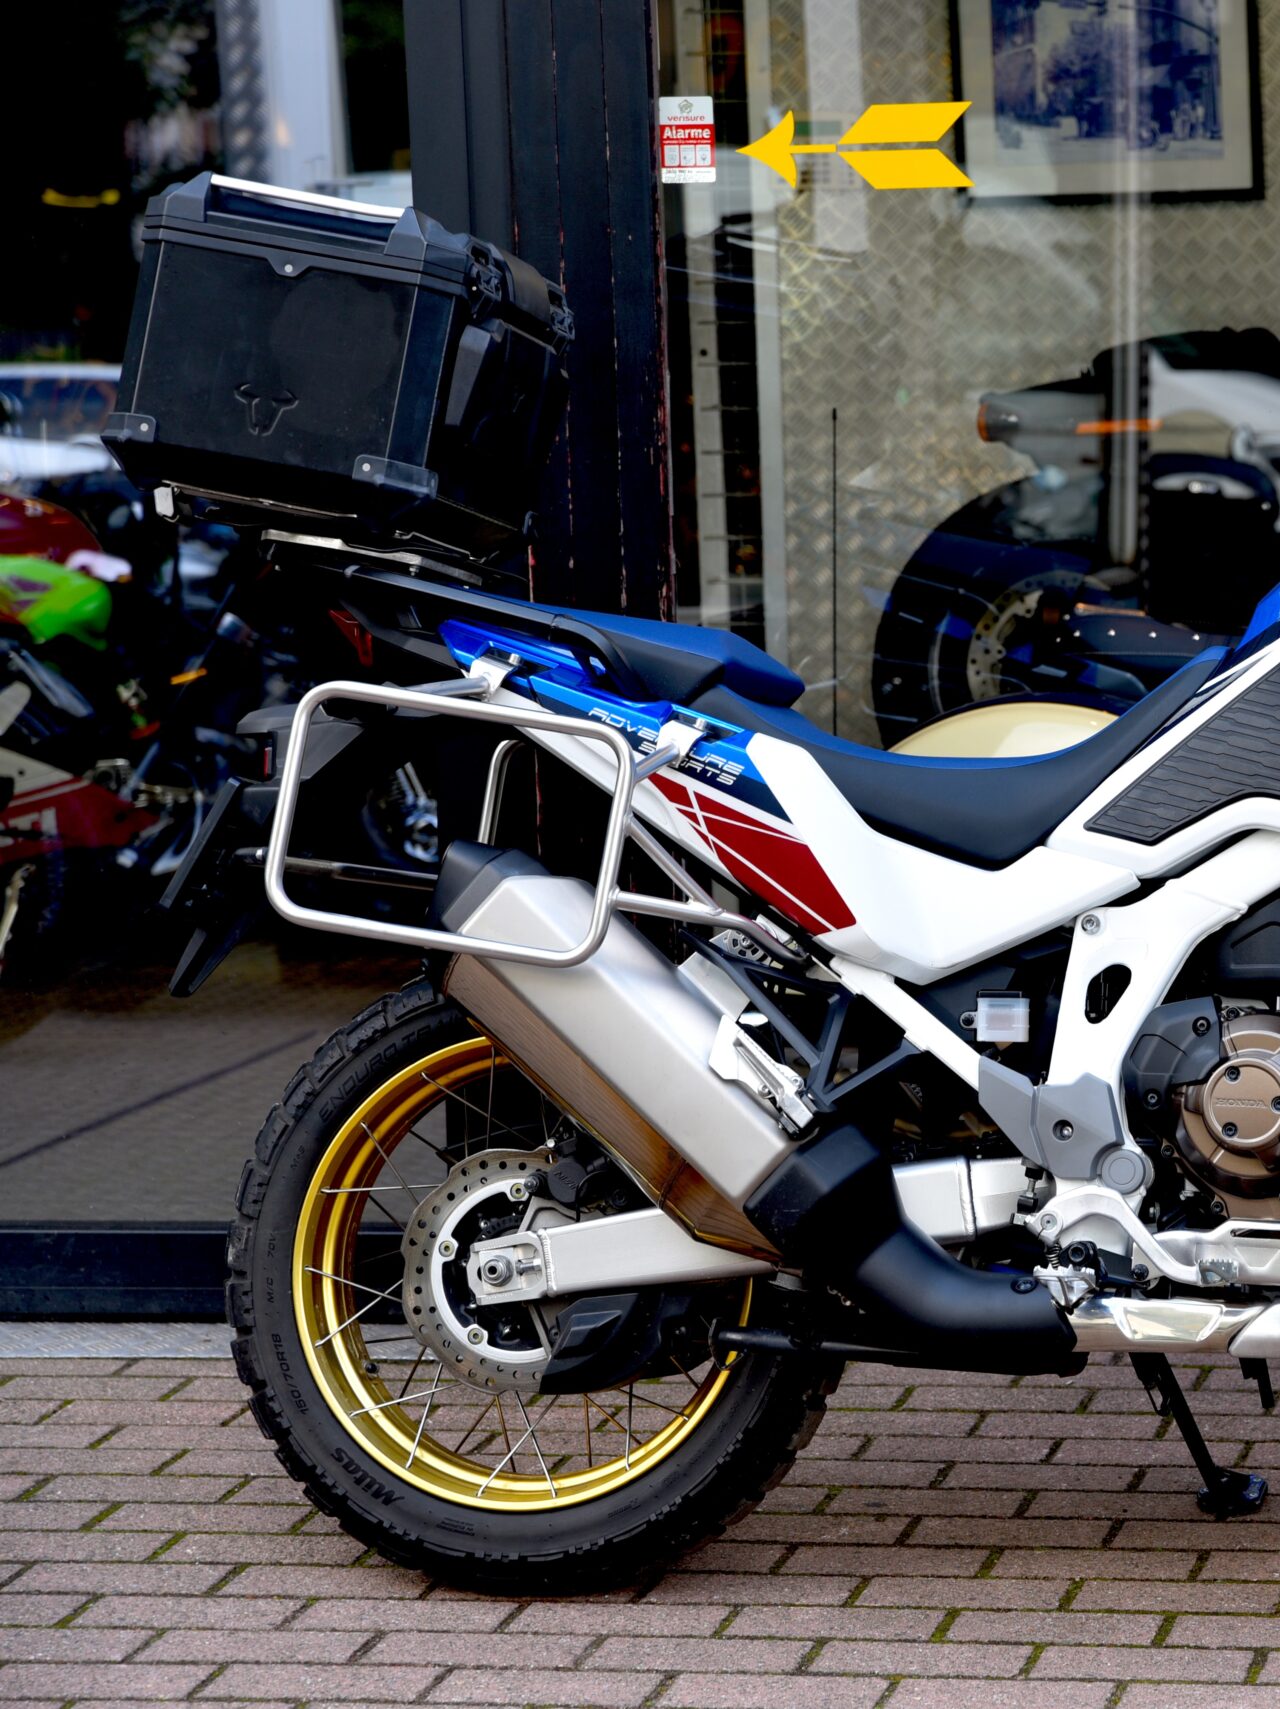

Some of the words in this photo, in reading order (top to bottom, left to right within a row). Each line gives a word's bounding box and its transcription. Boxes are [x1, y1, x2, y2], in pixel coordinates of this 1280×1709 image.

[663, 126, 711, 139] Alarme
[318, 1042, 399, 1121] ENDURO
[1215, 1097, 1268, 1109] HONDA
[331, 1446, 405, 1506] Mitas
